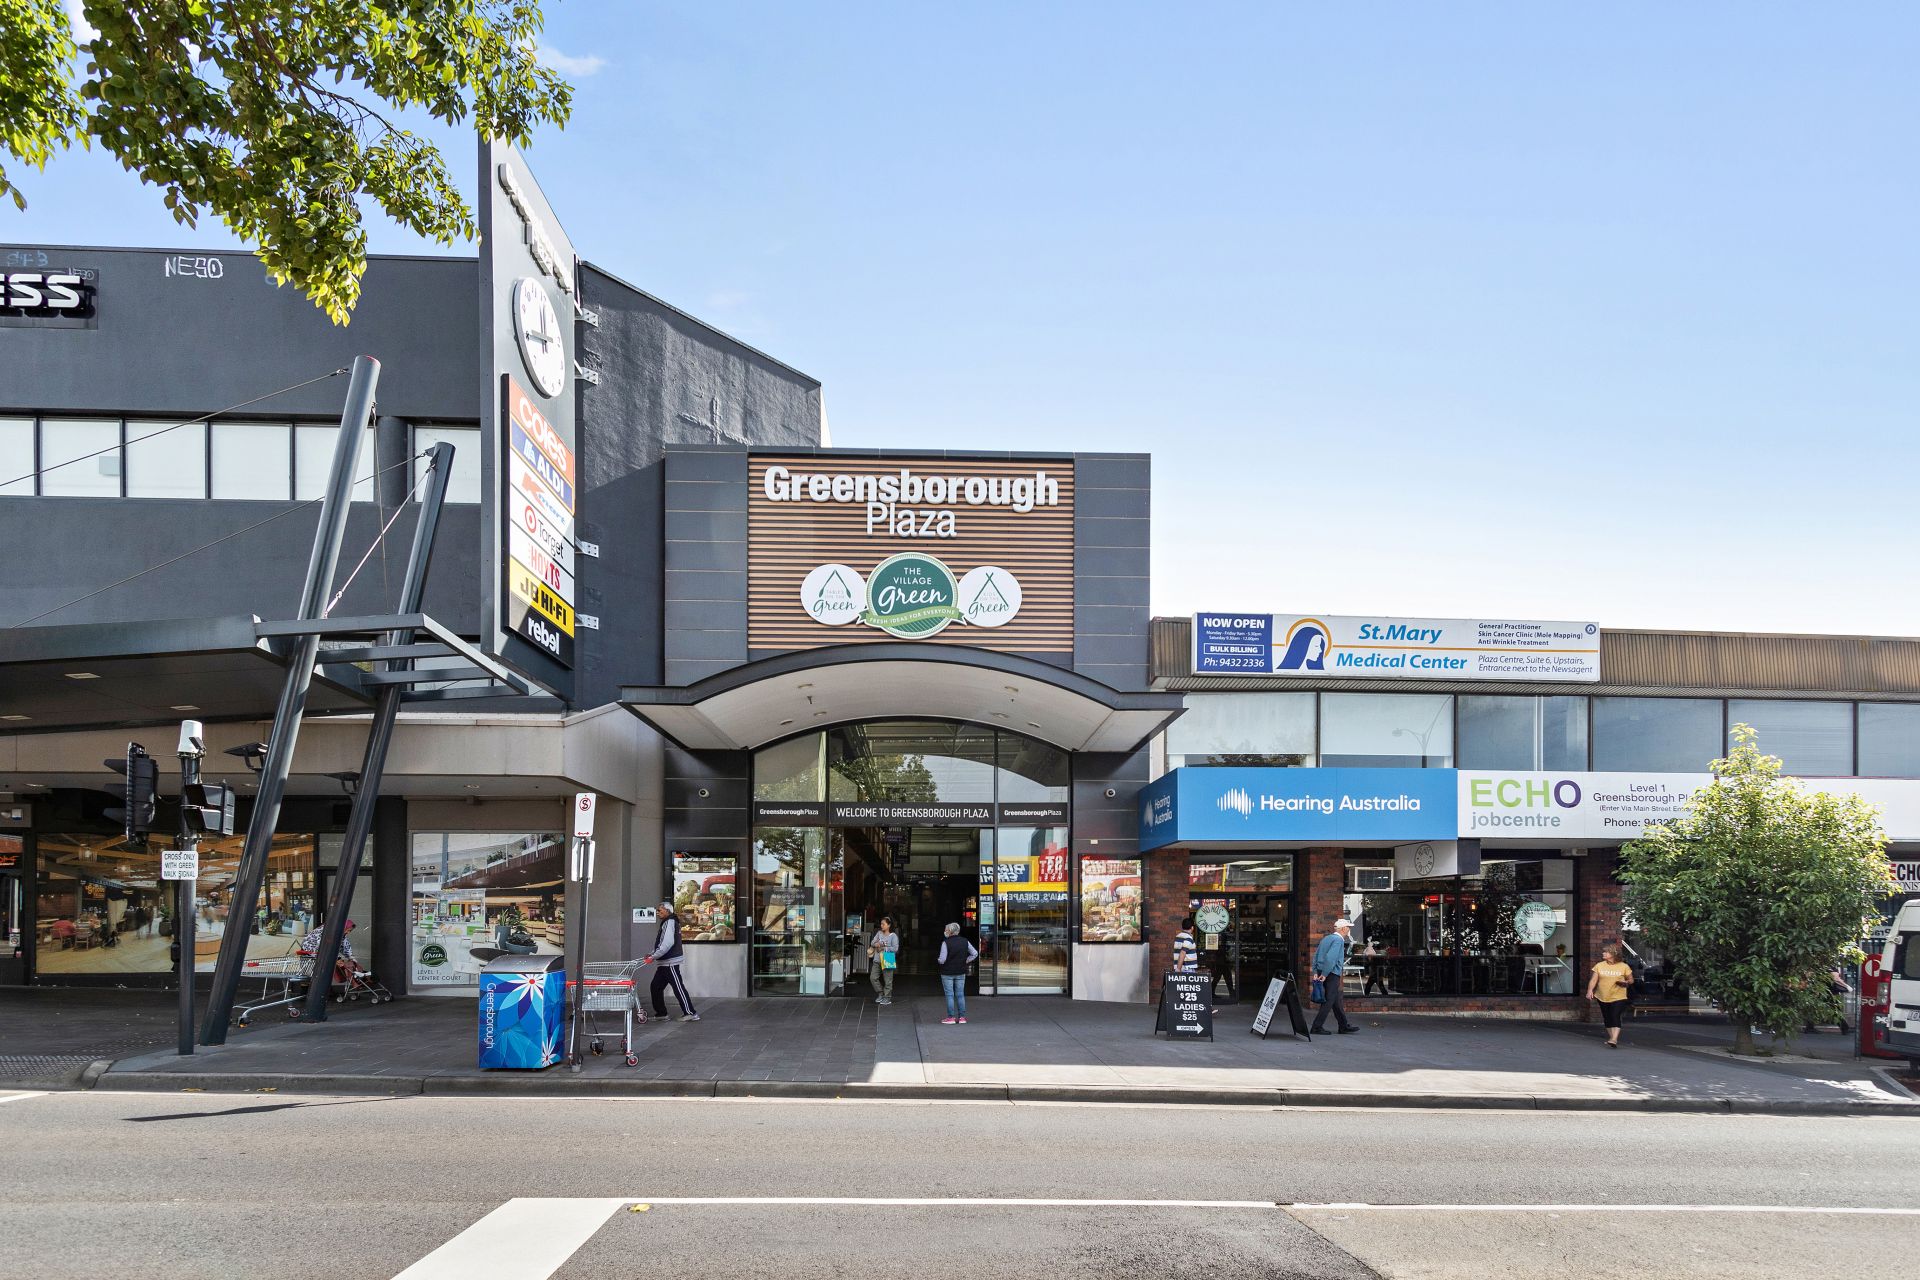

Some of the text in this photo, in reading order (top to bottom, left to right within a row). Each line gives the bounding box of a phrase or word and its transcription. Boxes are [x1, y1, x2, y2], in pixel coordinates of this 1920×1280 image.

[0, 273, 80, 308] SS
[536, 452, 565, 498] ALDI
[764, 466, 1058, 512] Greensborough
[866, 502, 958, 538] Plaza
[538, 520, 564, 559] Target
[530, 546, 560, 590] HOYTS
[904, 568, 921, 576] THE
[893, 577, 932, 586] VILLAGE
[520, 577, 538, 604] JB
[1204, 618, 1264, 628] NOW OPEN
[528, 616, 560, 656] rebel
[1204, 658, 1264, 667] Ph: 9432 2336
[1336, 653, 1468, 669] Medical Center
[1500, 655, 1524, 664] Centre,
[1554, 657, 1584, 666] Upstairs,
[1552, 666, 1593, 674] Newsagent
[1470, 779, 1582, 808] ECHO
[1630, 784, 1666, 792] Level 1
[1154, 795, 1170, 810] Hearing
[1261, 795, 1420, 814] Hearing Australia
[1593, 792, 1674, 804] Greensborough
[836, 808, 989, 818] WELCOME TO GREENSBOROUGH PLAZA
[1154, 810, 1173, 825] Australia
[1471, 812, 1560, 830] jobcentre
[1604, 818, 1640, 827] Phone:
[1180, 993, 1197, 1001] $25
[484, 982, 496, 1049] Greensborough
